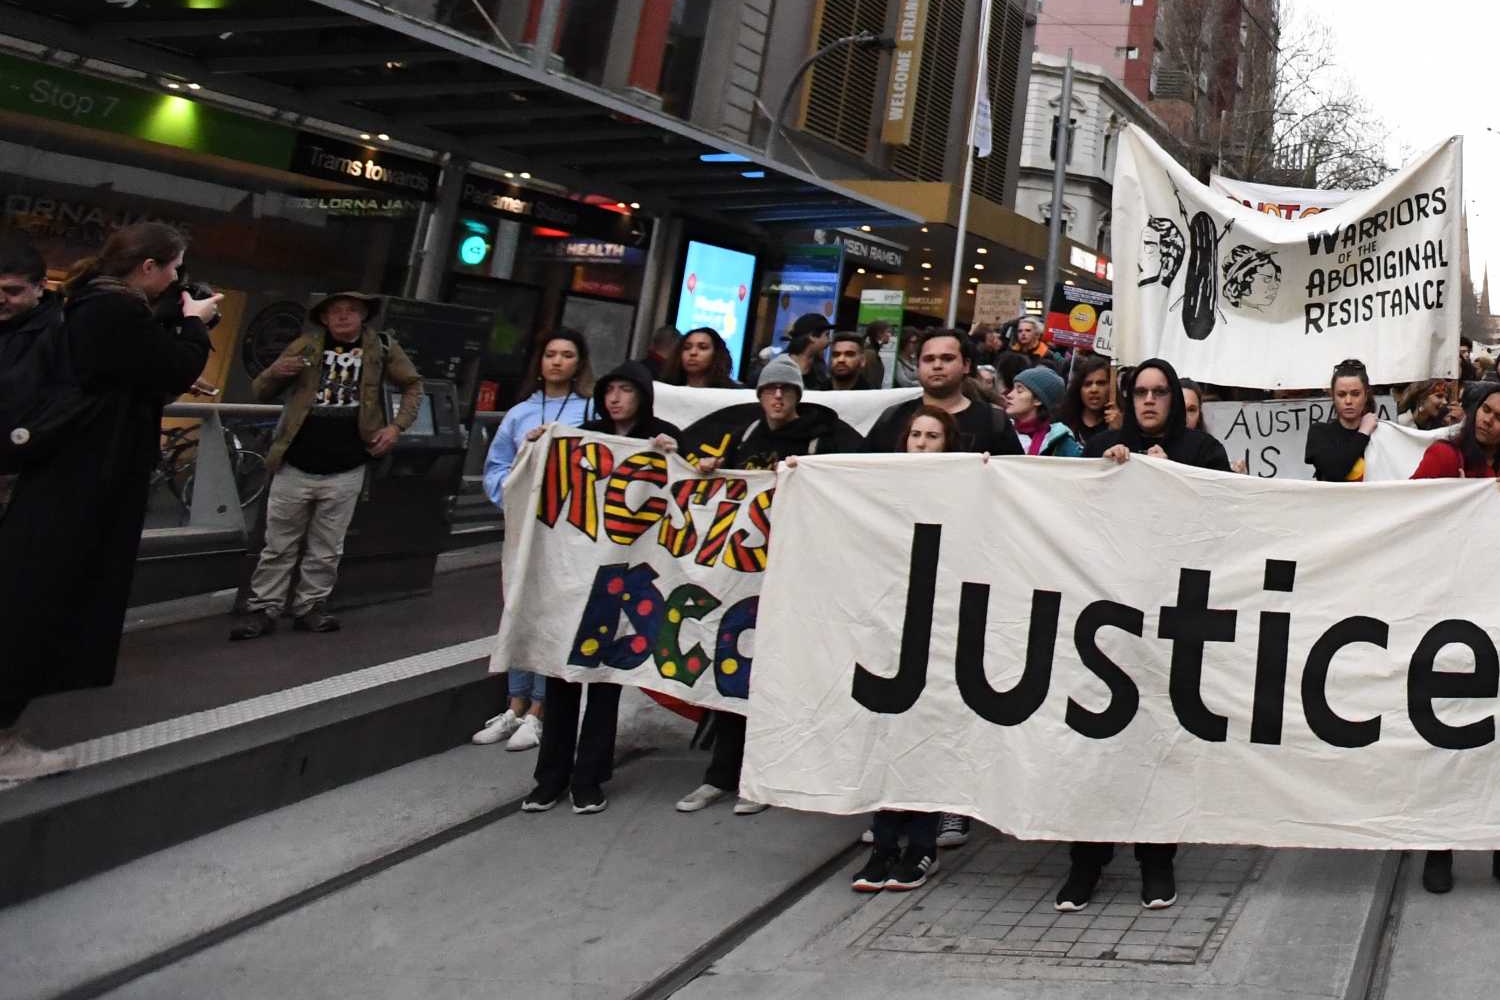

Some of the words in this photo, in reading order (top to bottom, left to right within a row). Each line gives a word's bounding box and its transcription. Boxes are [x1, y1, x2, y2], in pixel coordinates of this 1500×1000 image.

[29, 79, 95, 119] Stop
[102, 96, 120, 117] 7
[888, 50, 912, 121] WELCOME
[310, 146, 362, 175] Trams
[364, 158, 430, 191] towards
[319, 198, 377, 209] LORNA
[1307, 186, 1447, 256] WARRIORS
[567, 243, 625, 256] HEALTH
[869, 245, 902, 266] RAMEN
[1305, 238, 1449, 298] ABORIGINAL
[1338, 249, 1353, 264] OF
[1357, 241, 1377, 258] THE
[1304, 279, 1445, 335] RESISTANCE
[1245, 446, 1280, 479] IS
[852, 522, 1500, 750] Justice
